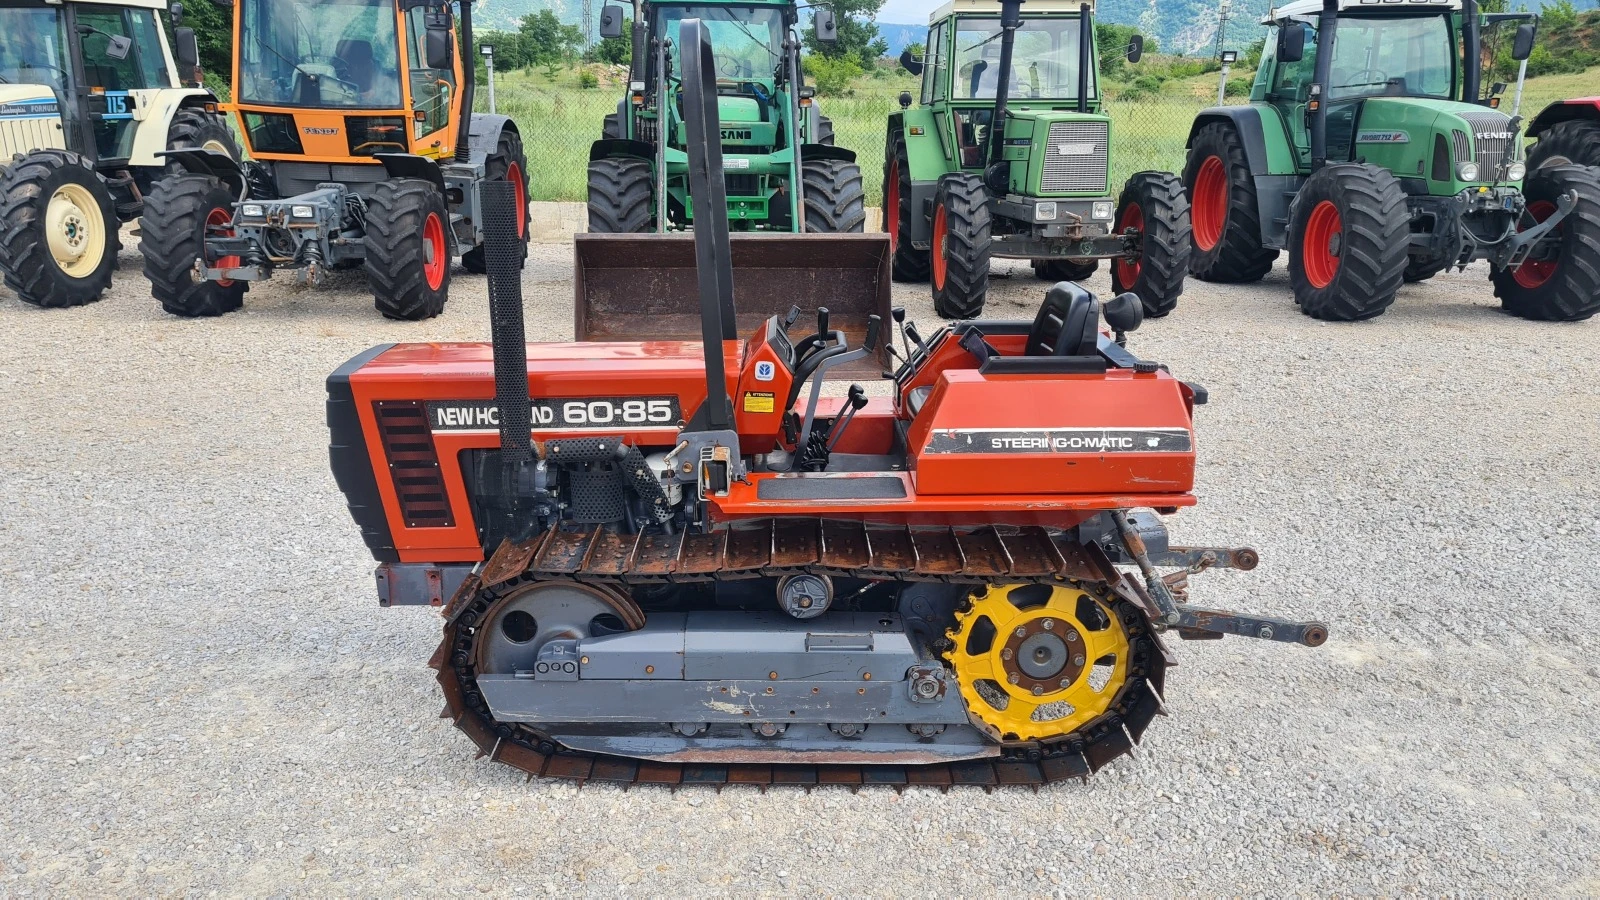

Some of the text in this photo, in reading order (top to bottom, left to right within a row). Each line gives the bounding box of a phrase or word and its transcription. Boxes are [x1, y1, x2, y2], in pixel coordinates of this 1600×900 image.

[31, 104, 58, 113] FORMULA
[106, 96, 126, 113] 115
[302, 126, 339, 135] FENDT
[1476, 131, 1513, 139] FENDT
[437, 407, 473, 426] NEW
[476, 406, 554, 425] HOND
[991, 436, 1133, 449] STEERING-O-MATIC
